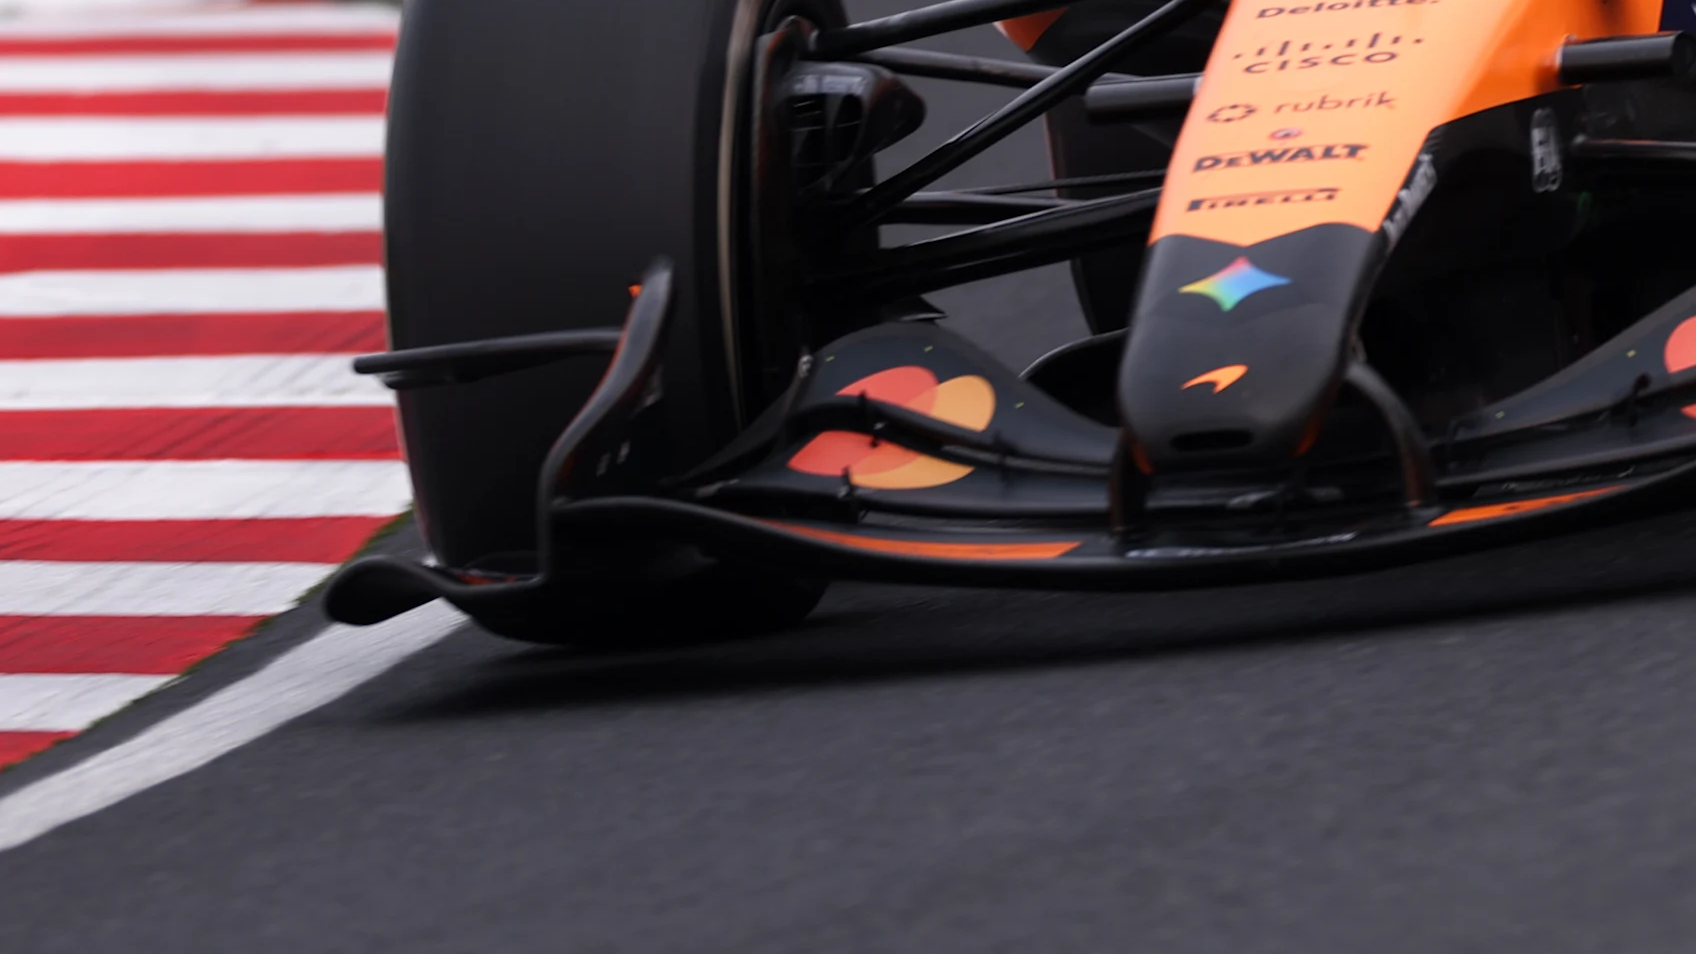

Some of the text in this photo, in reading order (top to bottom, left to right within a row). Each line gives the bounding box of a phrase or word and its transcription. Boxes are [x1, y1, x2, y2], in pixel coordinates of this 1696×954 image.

[1243, 51, 1398, 74] CISCO
[1274, 90, 1396, 115] rubrik
[1185, 187, 1343, 212] PIRELLI
